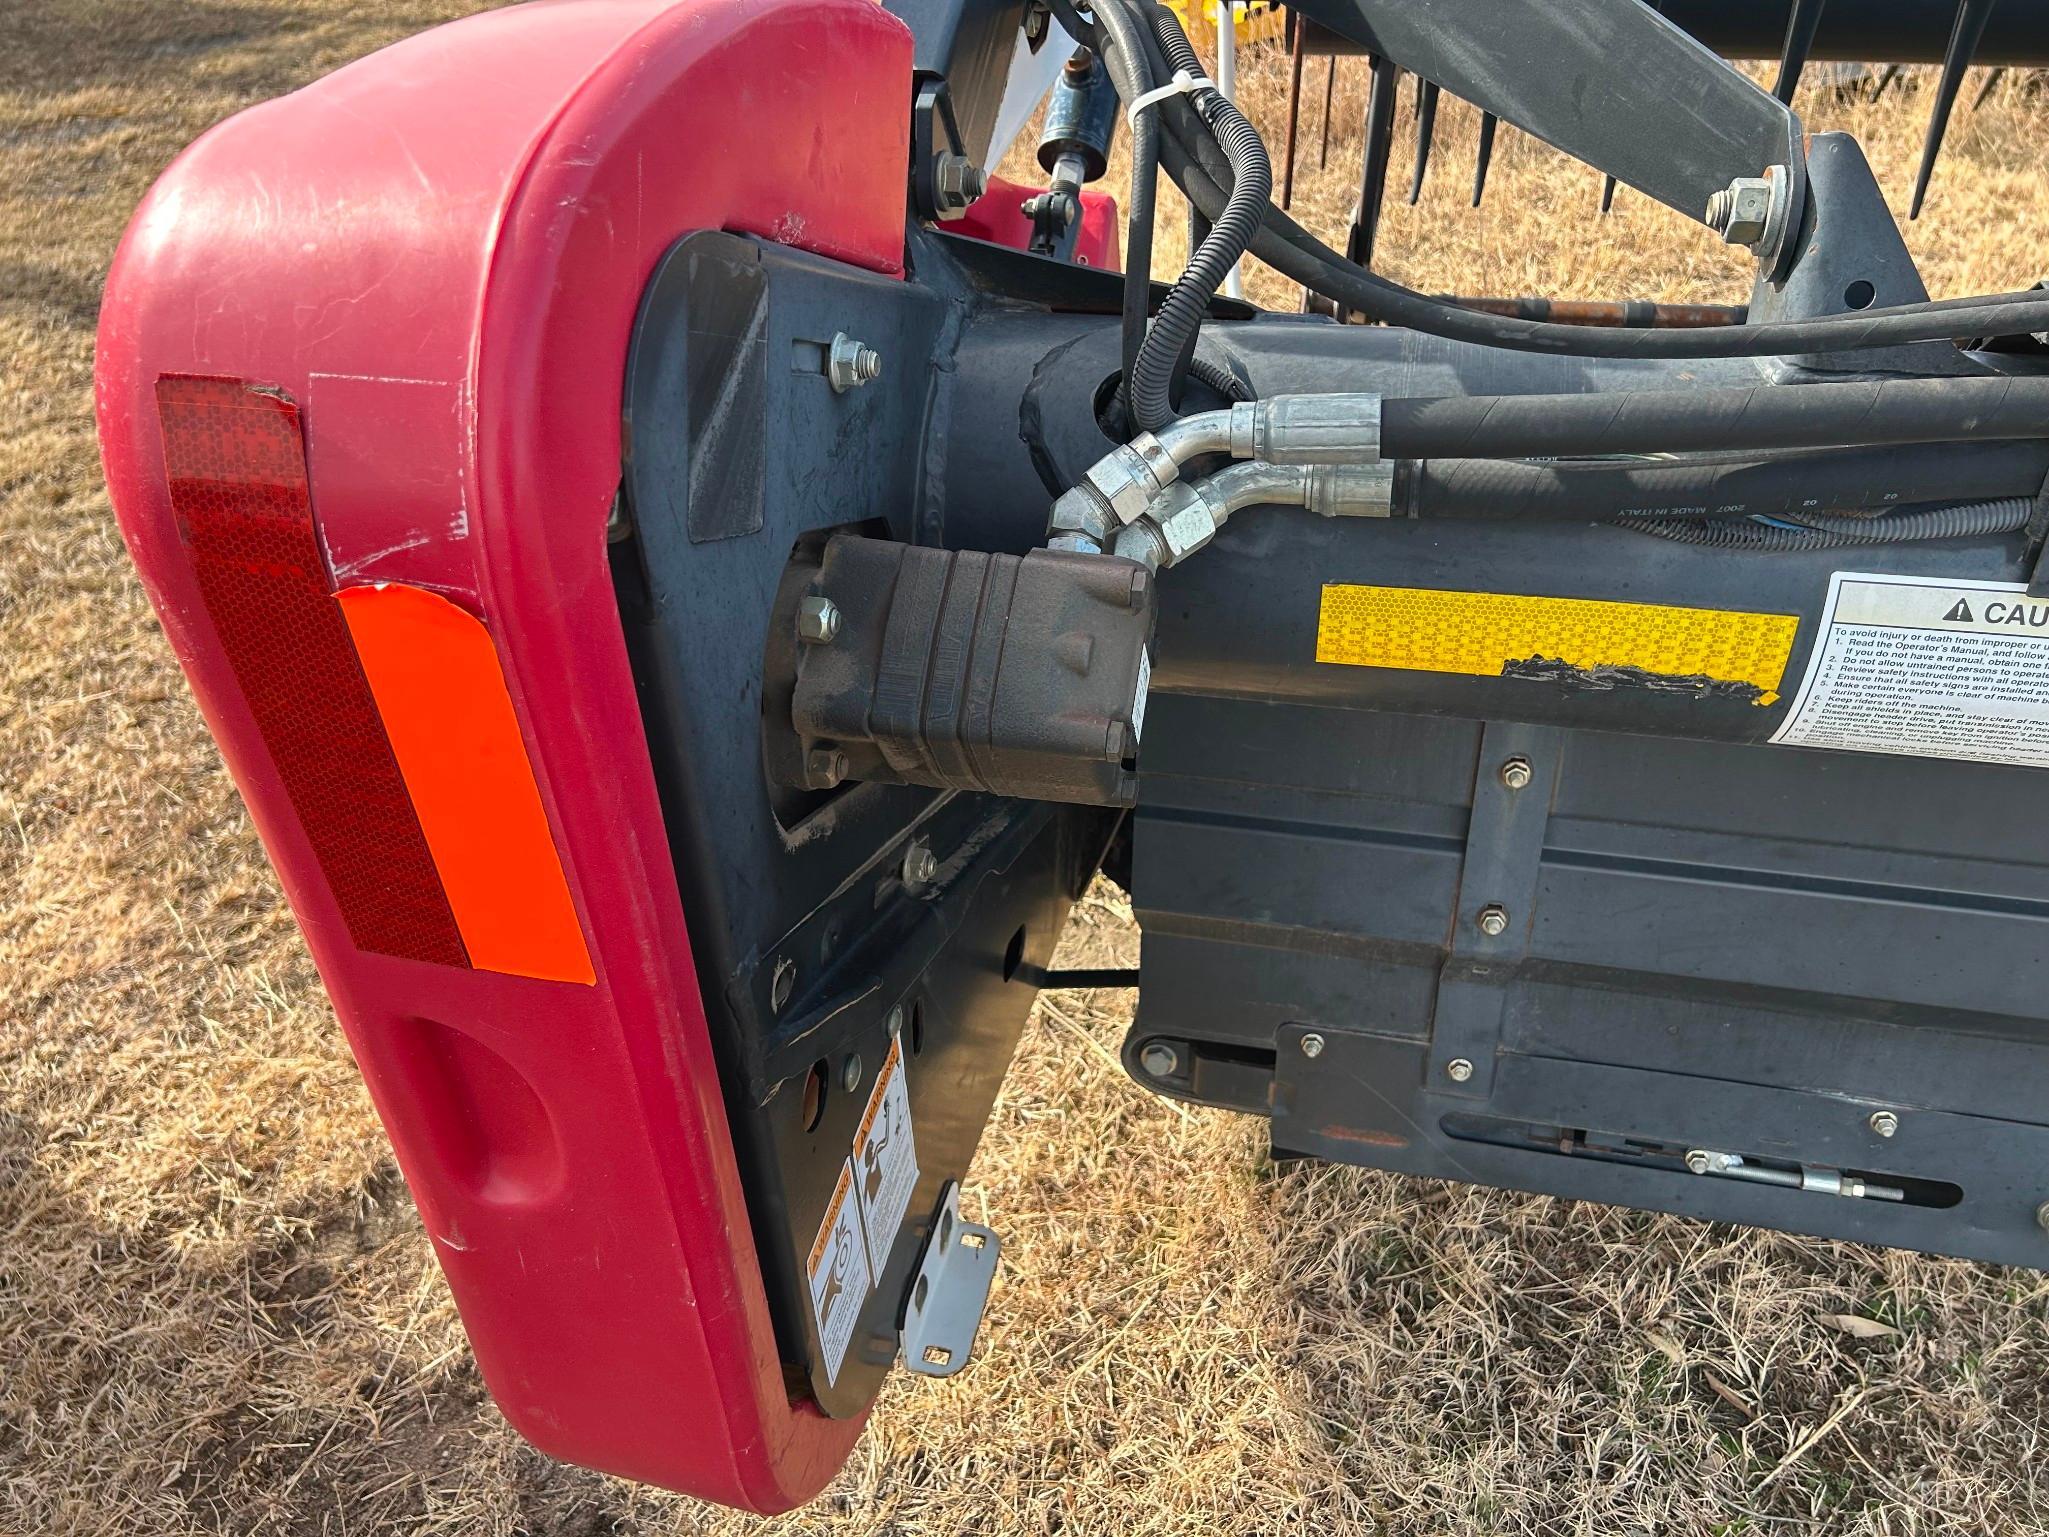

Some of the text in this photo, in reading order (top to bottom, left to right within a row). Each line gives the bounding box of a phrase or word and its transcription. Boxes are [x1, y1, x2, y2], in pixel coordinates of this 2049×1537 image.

[1617, 508, 1650, 516] ITALY
[1671, 506, 1706, 515] MADE
[1835, 628, 1847, 636] To
[1849, 629, 1877, 638] avoid
[1879, 630, 1909, 640] injury
[1924, 634, 1953, 643] death
[1955, 636, 1979, 645] from
[1981, 638, 2028, 649] improper
[1848, 639, 1874, 647] Read
[1877, 640, 1893, 648] the
[1895, 641, 1948, 653] Operator's
[1950, 646, 1989, 656] Manual,
[1992, 649, 2012, 658] and
[2014, 650, 2045, 660] follow
[1854, 649, 1874, 657] you
[1875, 649, 1889, 657] do
[1891, 651, 1908, 659] not
[1910, 653, 1934, 661] have
[1945, 656, 1985, 665] manual,
[1988, 657, 2020, 667] obtain
[1840, 665, 1876, 674] Review
[1877, 668, 1909, 678] safety
[1910, 670, 1972, 681] instructions
[1972, 674, 1994, 683] with
[1995, 676, 2009, 684] all
[1859, 658, 1876, 666] not
[1878, 659, 1904, 668] allow
[1906, 662, 1954, 672] untrained
[1956, 665, 1998, 675] persons
[2000, 668, 2011, 676] to
[1834, 681, 1860, 689] Make
[1862, 683, 1896, 692] certain
[1897, 686, 1943, 696] everyone
[1945, 689, 1955, 697] is
[1957, 691, 1982, 699] clear
[1996, 695, 2040, 703] machine
[1837, 673, 1872, 681] Ensure
[1874, 675, 1893, 683] that
[1895, 676, 1908, 685] all
[1909, 679, 1940, 688] safety
[1942, 681, 1970, 690] signs
[1990, 685, 2034, 695] installed
[1828, 695, 1853, 703] Keep
[1855, 697, 1883, 706] riders
[1885, 699, 1900, 707] off
[1919, 702, 1962, 712] machine.
[1831, 688, 1913, 701] during operation.
[1821, 708, 1872, 718] Disengage
[1874, 712, 1907, 721] header
[1909, 716, 1936, 724] drive,
[1957, 720, 2022, 730] transmission
[1825, 702, 1849, 710] Keep
[1865, 705, 1900, 713] shields
[1914, 710, 1942, 718] place,
[1967, 714, 1989, 722] stay
[1818, 715, 1868, 723] movement
[1906, 721, 1937, 729] before
[1939, 724, 1974, 733] leaving
[1853, 723, 1883, 731] engine
[1984, 734, 2020, 742] ignition
[1809, 728, 1845, 736] Engage
[1846, 732, 1900, 741] mechanical
[1919, 734, 1972, 743] unplugging
[819, 1173, 850, 1251] WARNING
